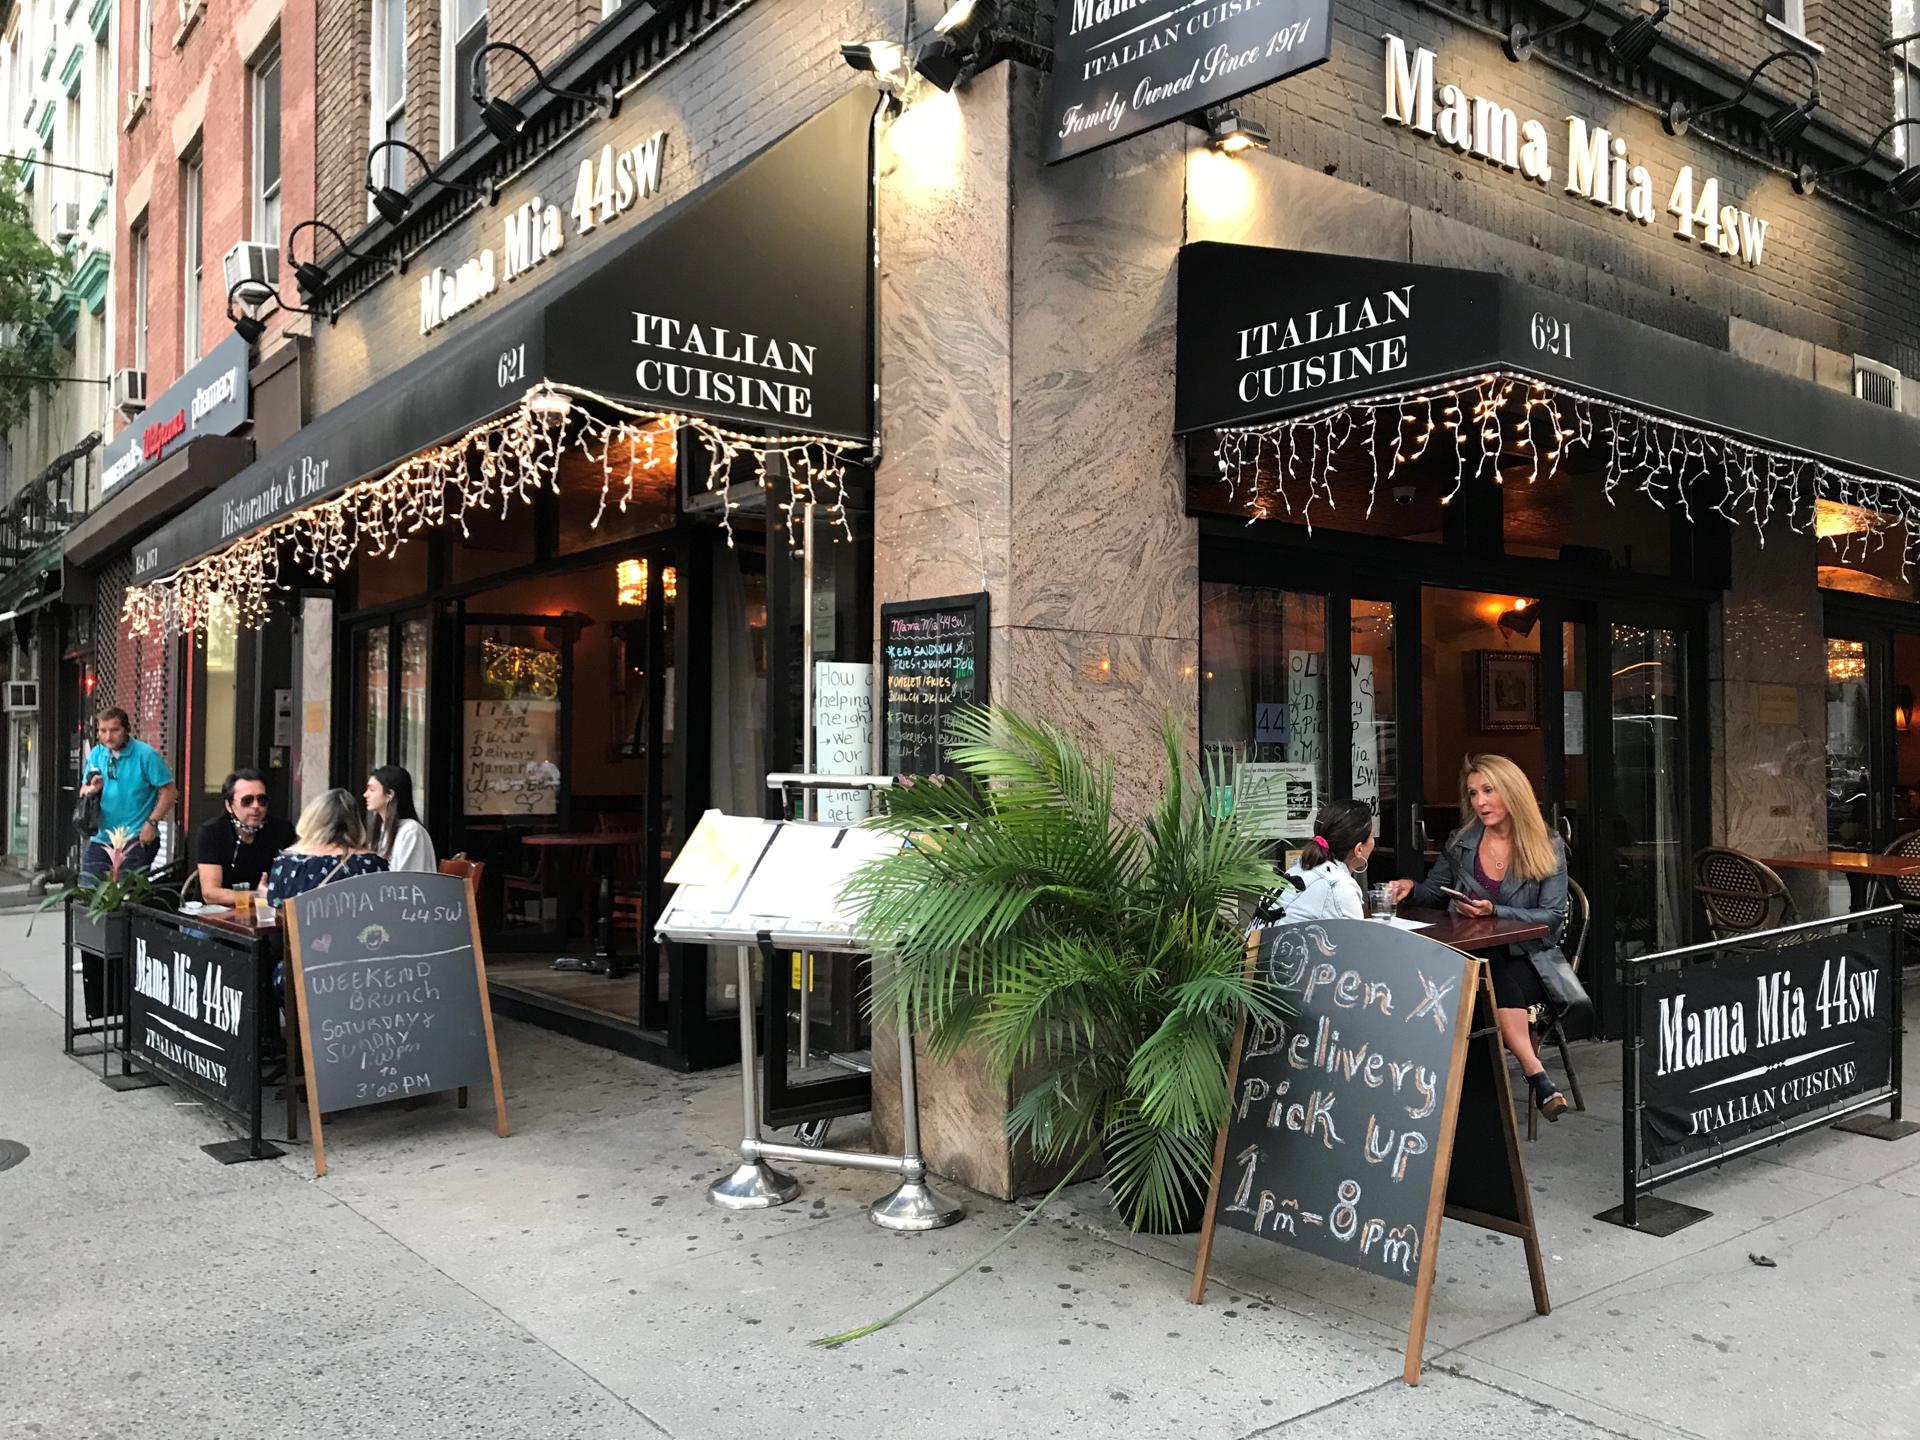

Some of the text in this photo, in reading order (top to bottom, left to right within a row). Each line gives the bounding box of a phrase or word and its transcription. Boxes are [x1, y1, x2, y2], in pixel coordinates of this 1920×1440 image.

[1082, 0, 1263, 81] ITALIAN CUISI
[1059, 17, 1311, 138] Family Owned Since 1971
[1381, 33, 1551, 184] Mama
[1564, 115, 1655, 223] Mia
[419, 248, 496, 336] Mama
[503, 196, 563, 281] Mia
[632, 312, 817, 376] ITALIAN
[1235, 284, 1415, 361] ITALIAN
[1531, 311, 1575, 359] 621
[498, 344, 526, 388] 621
[636, 359, 812, 417] CUISINE
[1238, 335, 1408, 402] CUISINE
[221, 456, 329, 539] Ristorante & Bar
[819, 688, 872, 712] helping
[820, 664, 854, 686] How
[1257, 708, 1285, 734] 44
[826, 790, 862, 803] time
[828, 805, 855, 823] get
[306, 884, 427, 926] MAMA MIA
[134, 937, 170, 1006] Mama
[172, 951, 198, 1019] Mia
[312, 961, 431, 995] WEEKEND
[1266, 926, 1395, 1017] Open
[1657, 994, 1747, 1076] Mama
[1756, 971, 1807, 1049] Mia
[145, 1027, 227, 1087] ITALIAN CUISINE
[1246, 1015, 1437, 1121] Delivery
[1688, 1061, 1857, 1136] ITALIAN CUISINE
